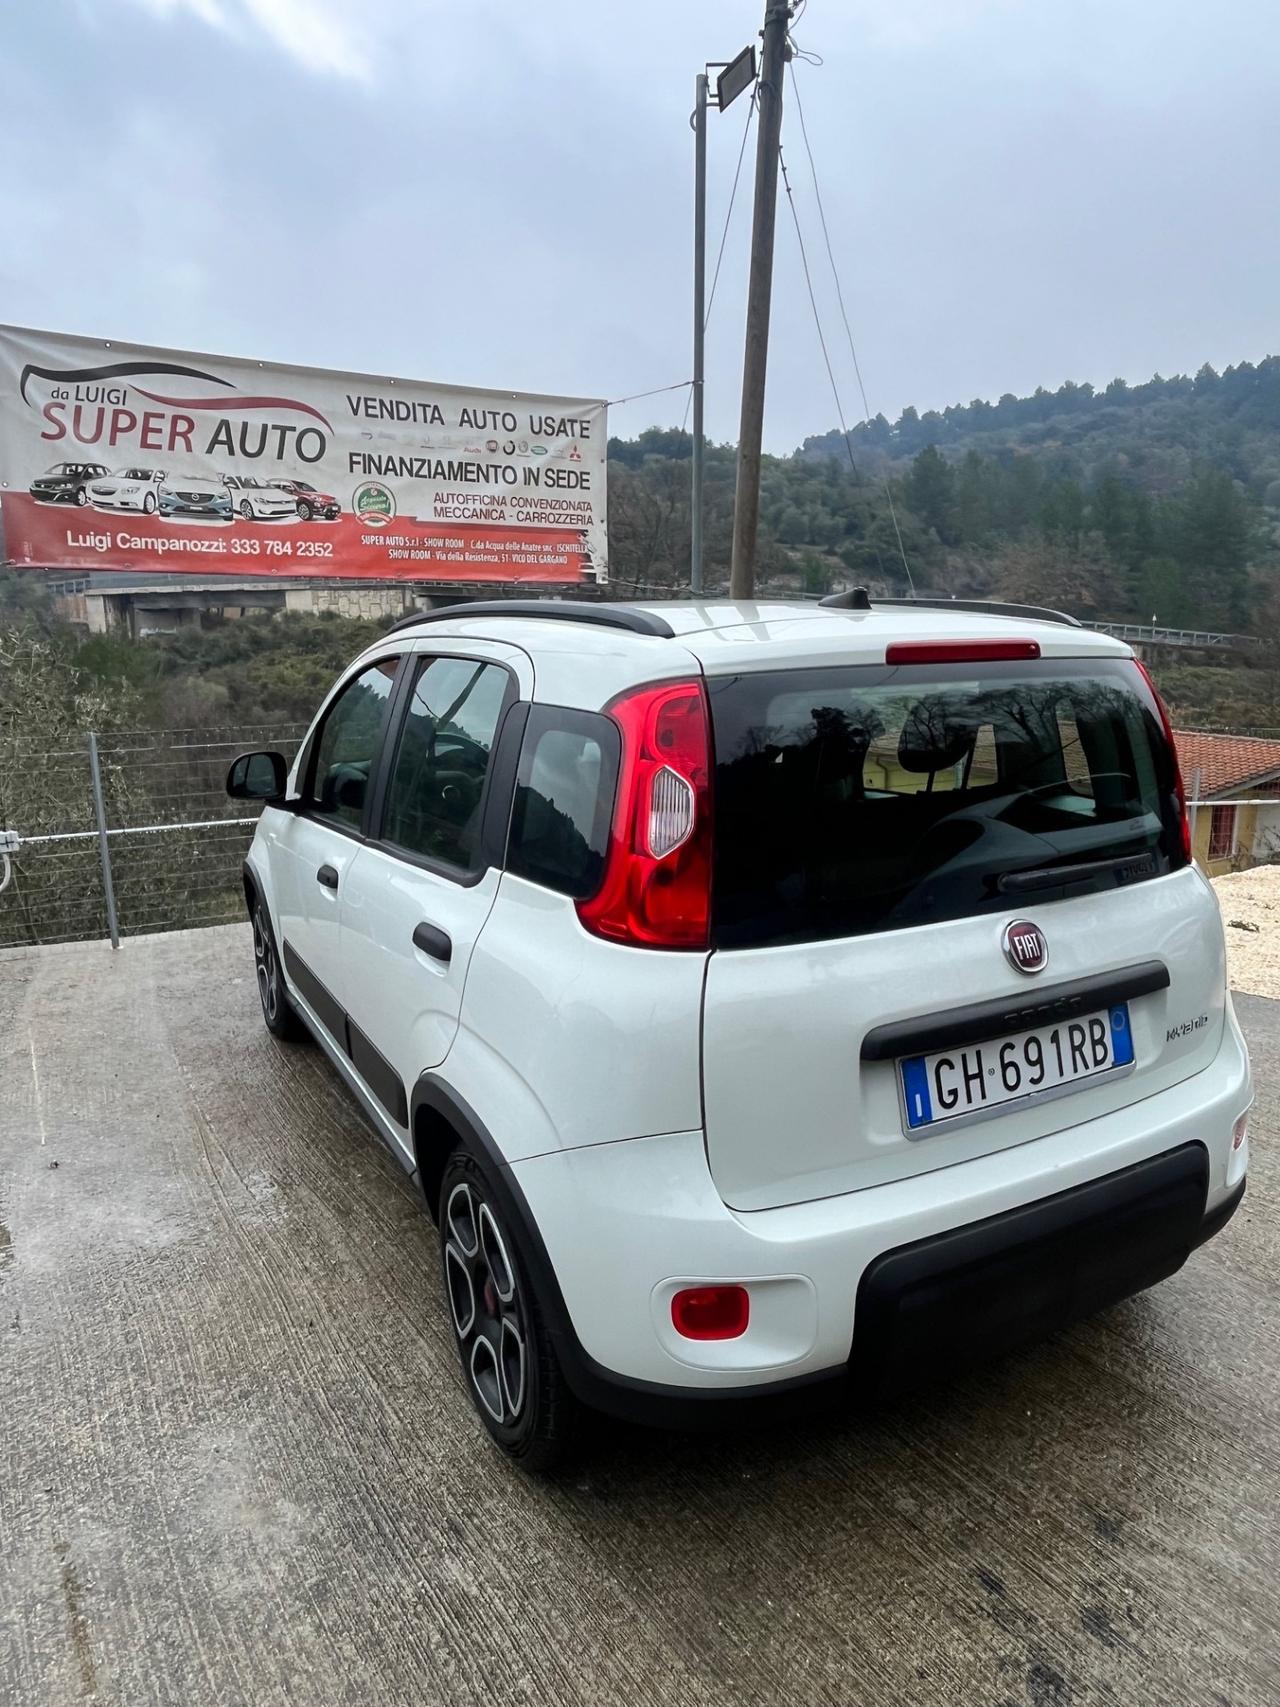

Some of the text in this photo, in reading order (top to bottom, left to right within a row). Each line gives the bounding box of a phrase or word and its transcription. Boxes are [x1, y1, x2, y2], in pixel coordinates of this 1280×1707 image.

[51, 384, 128, 406] da LUIGI
[346, 394, 591, 439] VENDITA AUTO USATE
[40, 402, 327, 463] SUPER AUTO
[348, 451, 591, 490] FINANZIAMENTO IN SEDE
[433, 491, 593, 513] AUTOFFICINA CONVENZIONATA
[433, 506, 506, 521] MECCANICA
[516, 510, 594, 526] CARROZZERIA
[66, 530, 333, 557] Luigi Campanozzi: 333 784 2352
[361, 534, 385, 545] SUPER
[385, 536, 404, 546] AUTO
[424, 537, 444, 548] SHOW
[445, 538, 464, 548] ROOM
[505, 541, 520, 551] delle
[388, 548, 410, 559] SHOW
[410, 549, 431, 560] ROOM
[436, 550, 447, 561] Via
[447, 551, 464, 561] della
[512, 553, 526, 563] VICO
[526, 554, 538, 563] DEL
[539, 554, 568, 564] GARGANO
[1013, 933, 1041, 961] FIAT
